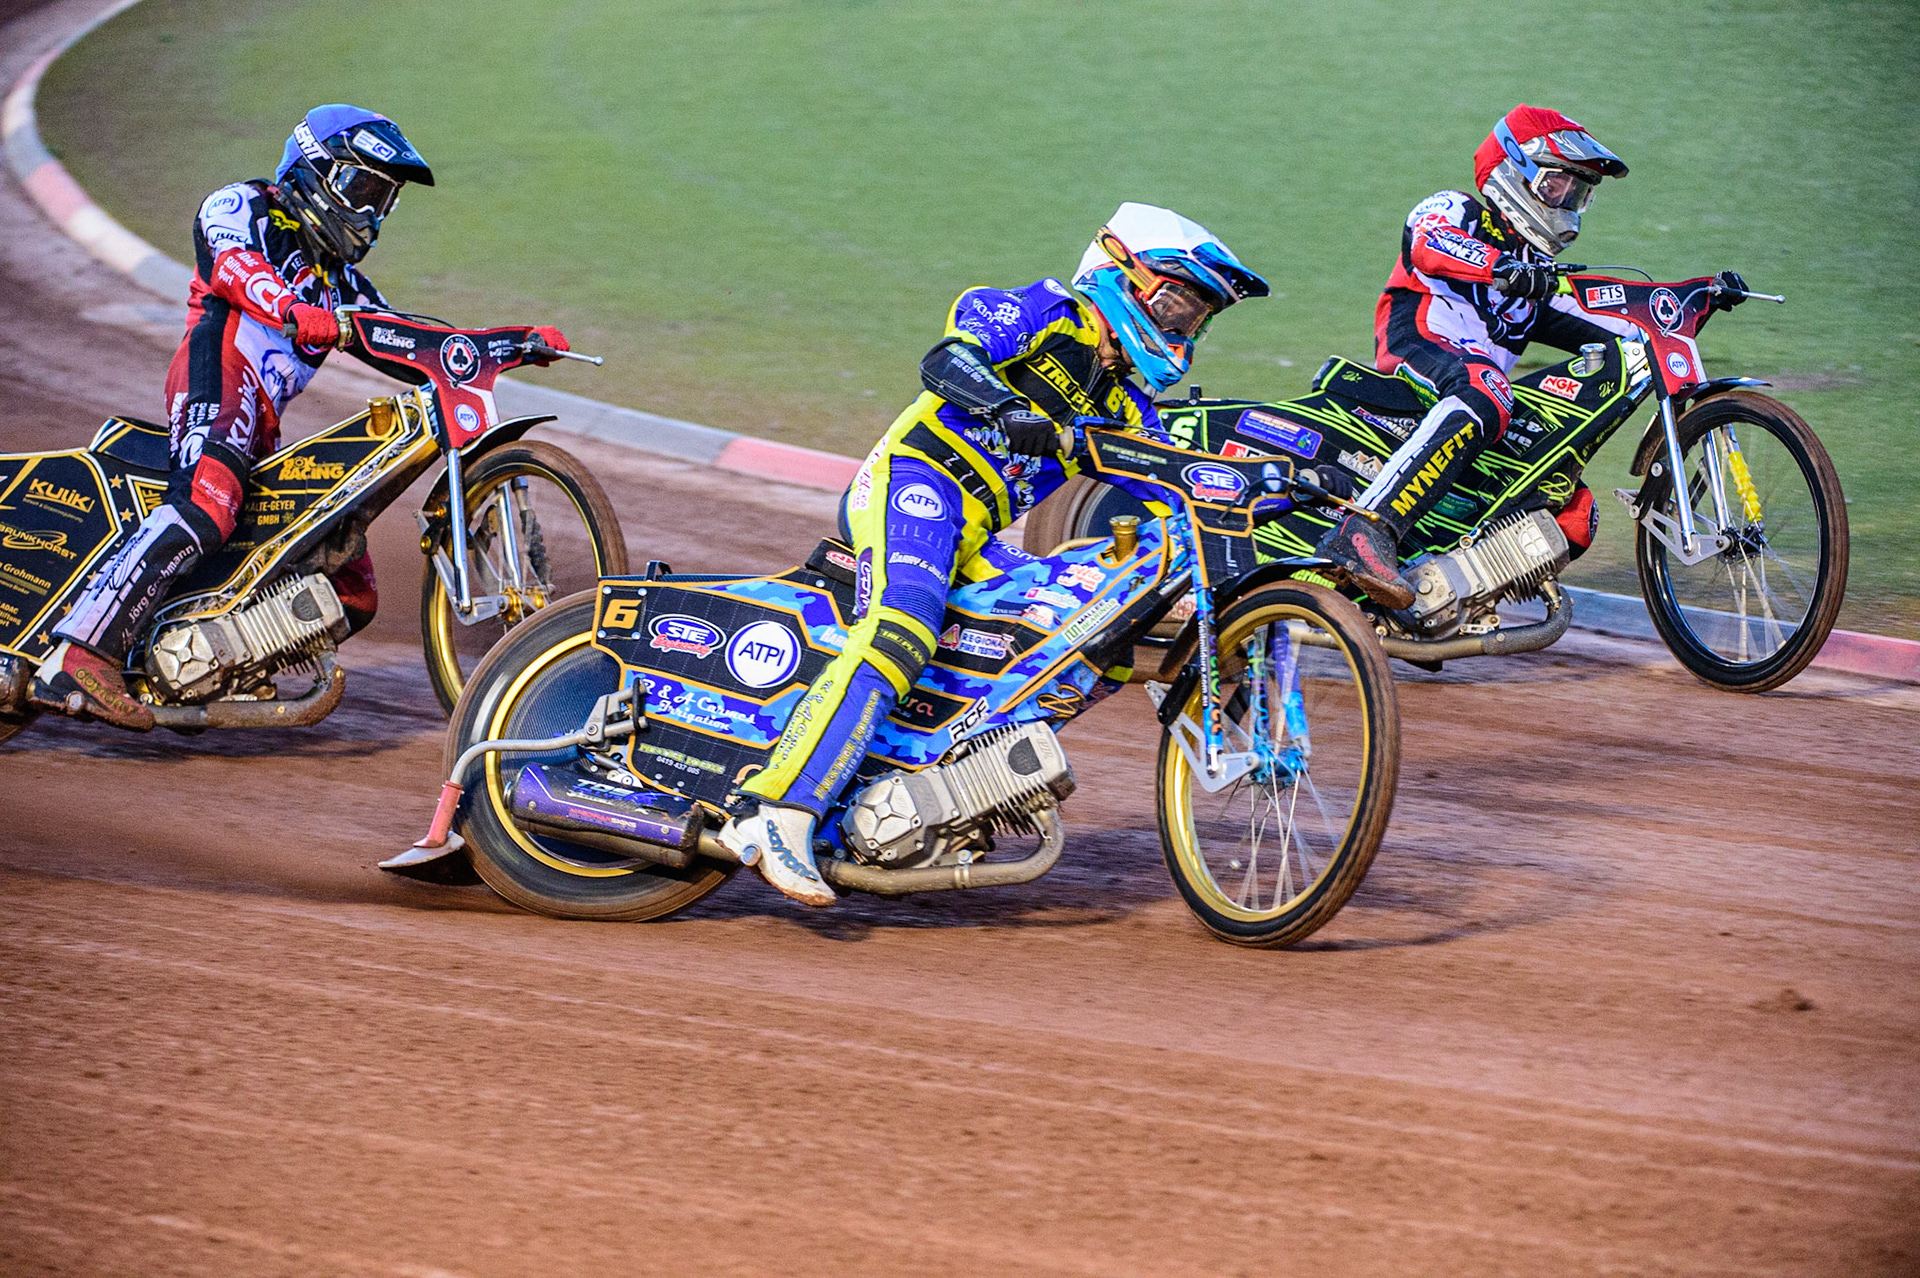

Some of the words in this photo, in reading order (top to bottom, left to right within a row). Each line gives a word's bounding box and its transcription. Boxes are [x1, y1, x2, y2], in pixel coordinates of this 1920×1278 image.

[223, 255, 251, 284] Stiftung
[236, 251, 260, 268] ADAC
[217, 265, 235, 286] Sport
[1599, 286, 1623, 300] FTS
[372, 335, 415, 349] RACING
[1544, 377, 1579, 394] NGK
[1106, 385, 1124, 413] 6
[278, 462, 345, 481] RACING
[1390, 420, 1478, 517] MYNEFIT
[1197, 469, 1236, 490] STE
[902, 492, 939, 511] ATPI
[256, 514, 280, 526] GMBH
[3, 563, 52, 589] Grohmann
[128, 596, 150, 625] Jörg
[146, 544, 195, 598] Grohmann
[601, 598, 643, 630] 6
[665, 621, 711, 645] STE
[962, 632, 1006, 649] REGIONAL
[737, 641, 786, 668] ATPI
[959, 642, 975, 654] FIRE
[976, 645, 1005, 658] TESTING
[658, 685, 673, 700] &
[658, 696, 731, 732] Irrigation
[949, 700, 989, 741] RCF
[766, 819, 820, 884] daytona
